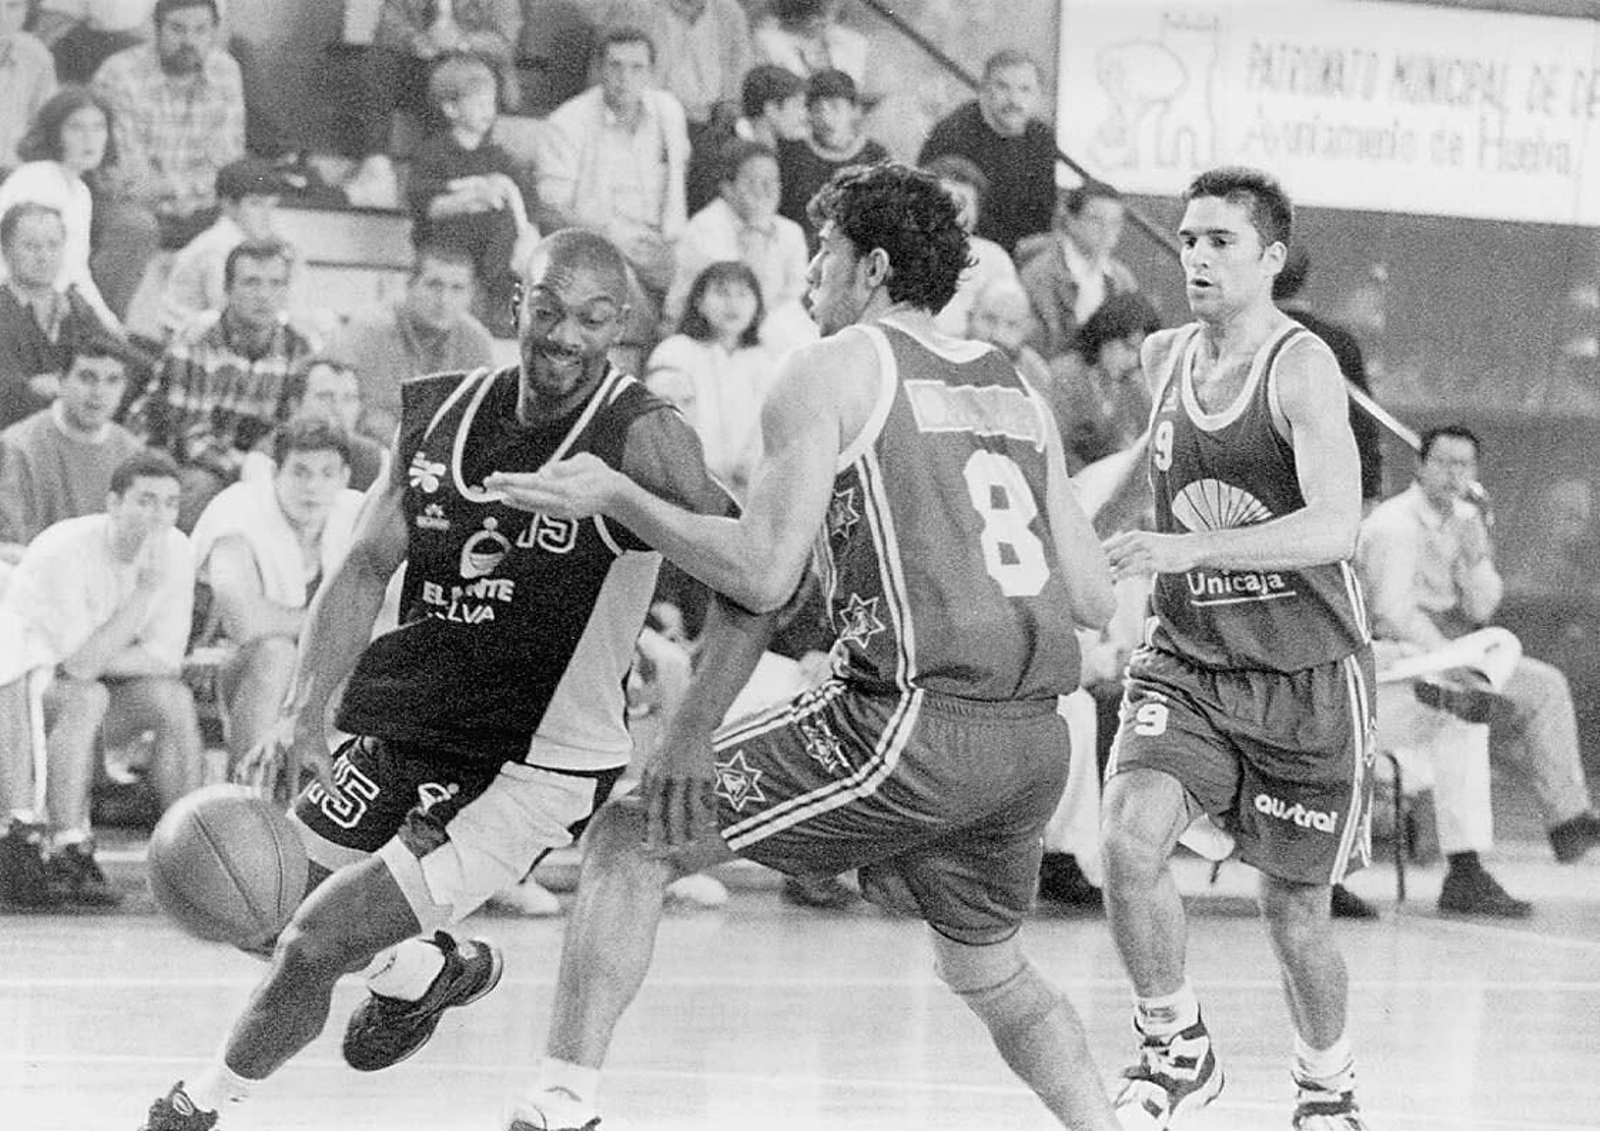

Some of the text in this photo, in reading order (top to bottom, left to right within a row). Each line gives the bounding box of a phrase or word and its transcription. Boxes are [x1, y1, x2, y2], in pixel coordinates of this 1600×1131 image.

[1155, 421, 1174, 471] 9
[963, 449, 1051, 596] 8
[1187, 569, 1285, 598] Unicaja
[1135, 703, 1169, 736] 9
